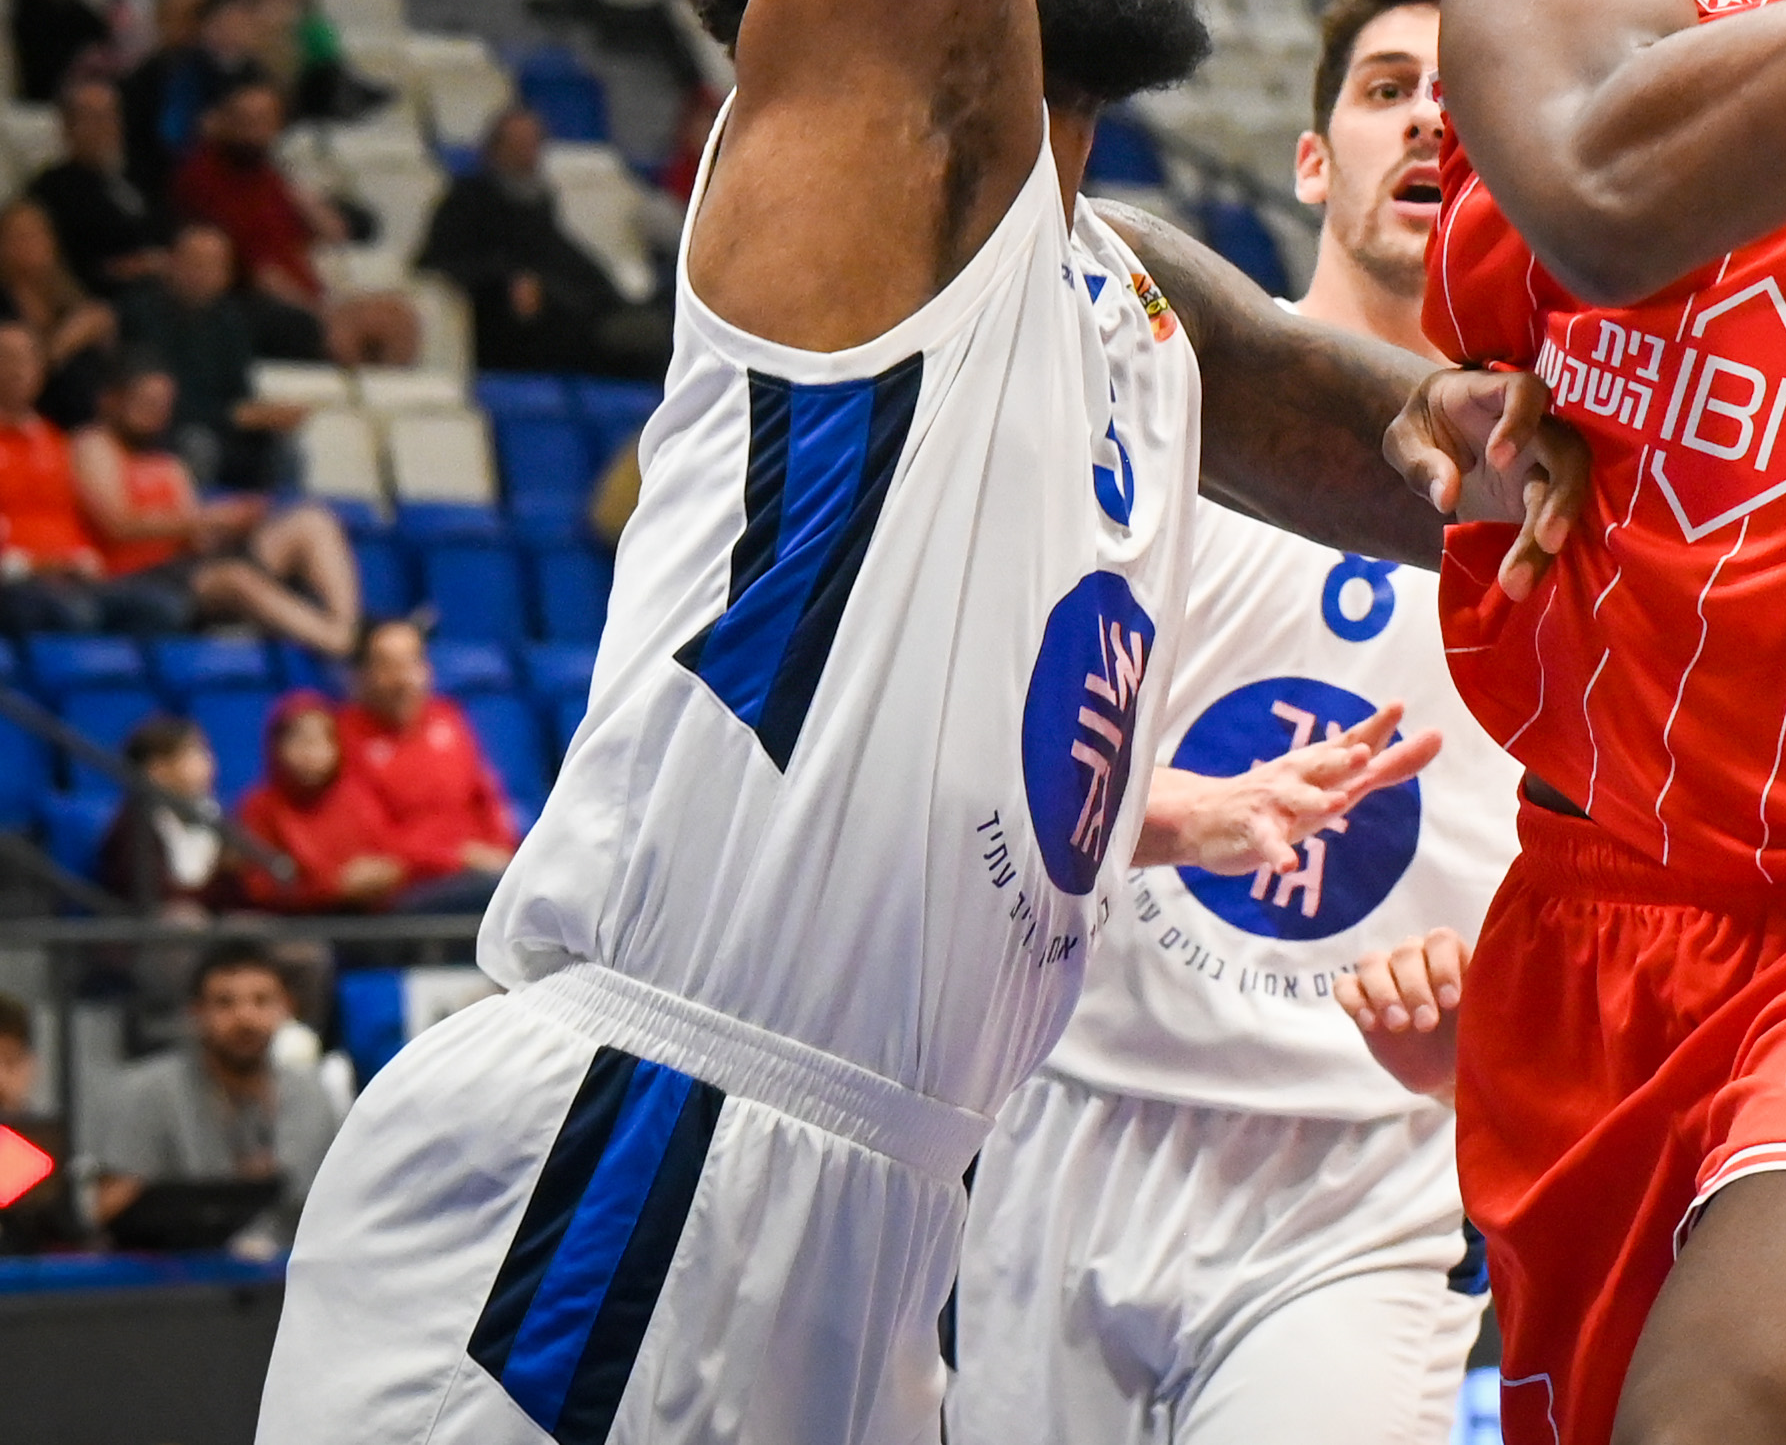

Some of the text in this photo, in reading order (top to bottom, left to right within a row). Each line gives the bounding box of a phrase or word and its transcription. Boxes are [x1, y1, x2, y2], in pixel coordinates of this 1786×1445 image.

[1534, 336, 1653, 430] השקעו
[1591, 319, 1666, 382] בית
[977, 810, 1017, 888] עתיד
